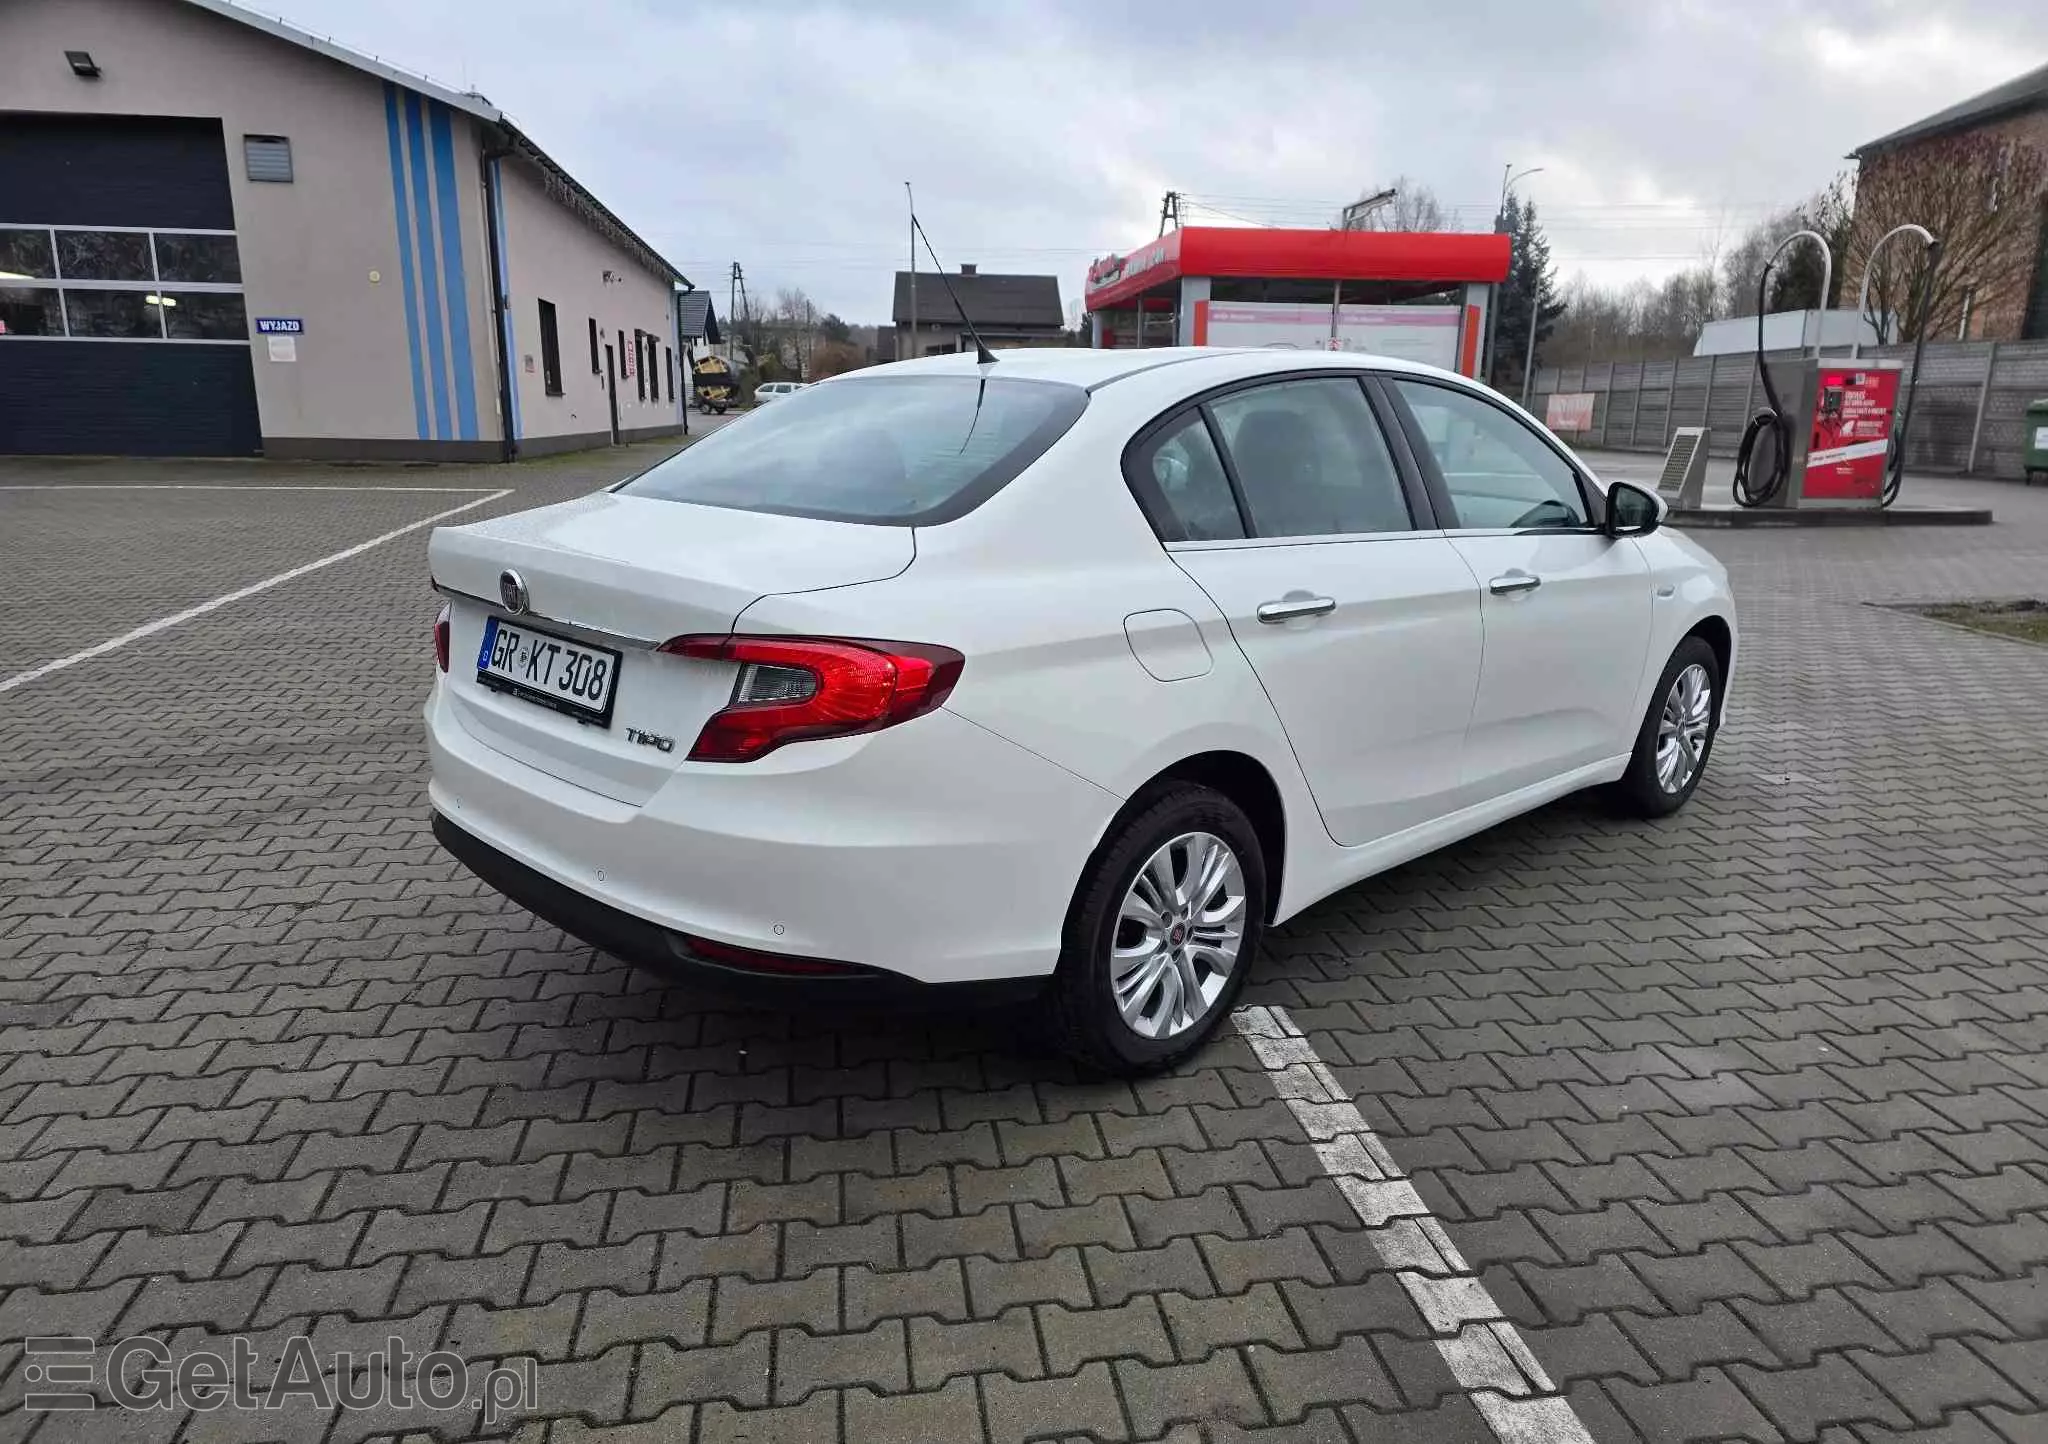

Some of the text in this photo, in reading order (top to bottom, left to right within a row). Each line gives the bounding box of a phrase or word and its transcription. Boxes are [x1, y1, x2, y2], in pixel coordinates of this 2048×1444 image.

[259, 320, 300, 331] WYJAZD
[491, 629, 521, 673] GR
[526, 639, 561, 685] KT
[558, 651, 607, 700] 308
[626, 727, 675, 753] TIPO
